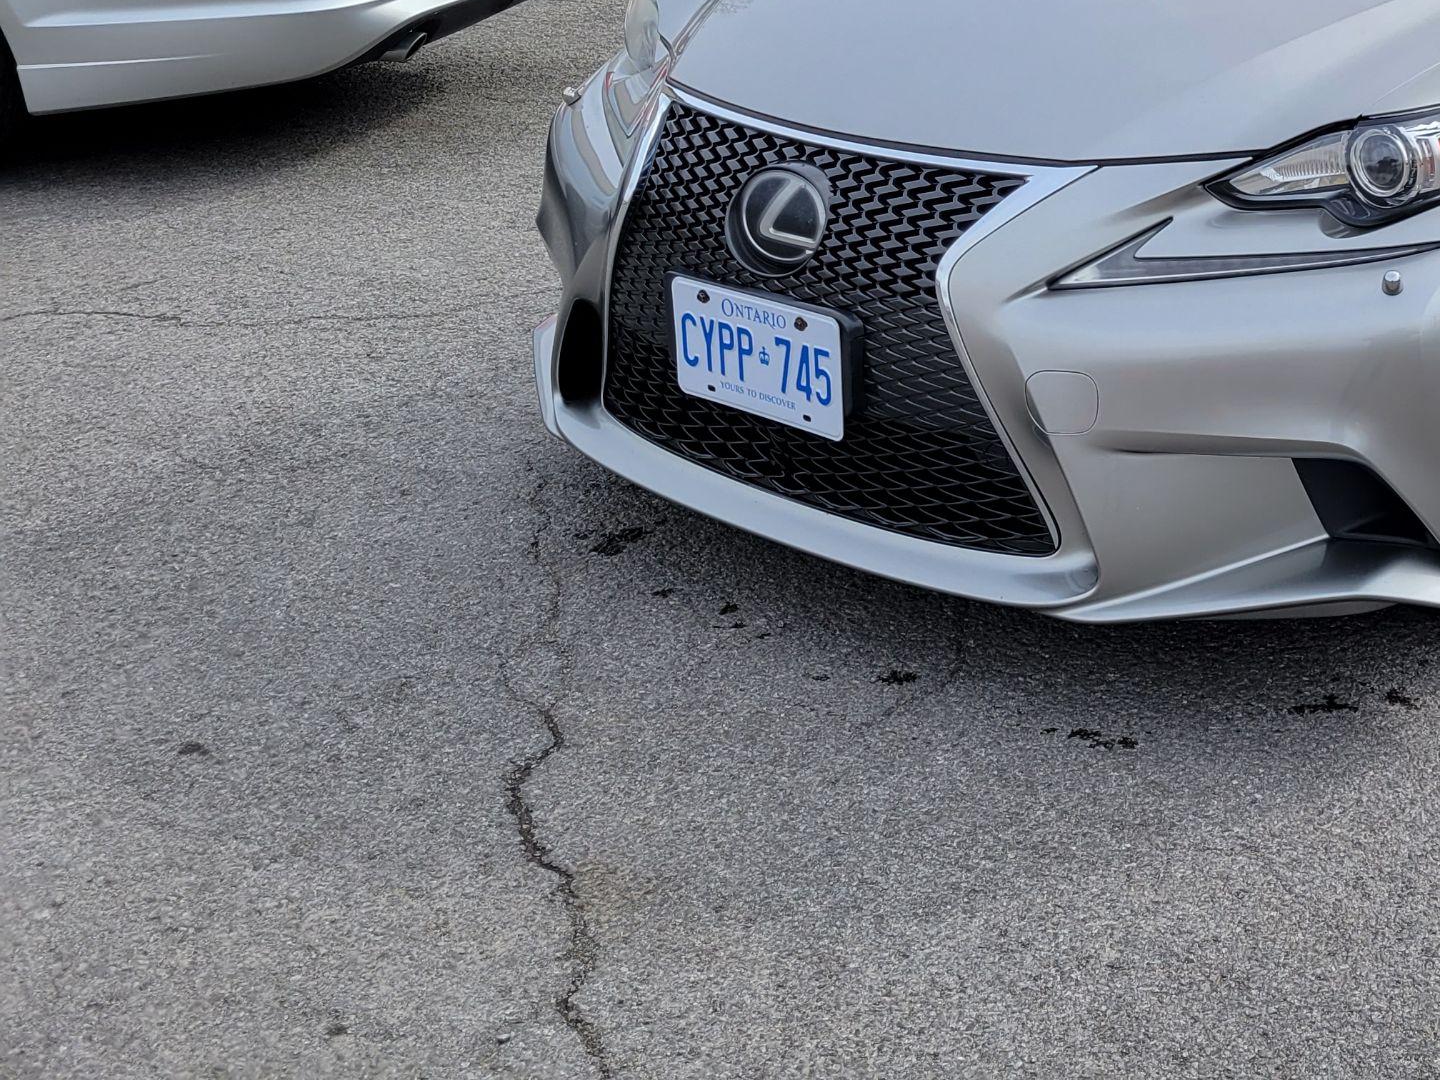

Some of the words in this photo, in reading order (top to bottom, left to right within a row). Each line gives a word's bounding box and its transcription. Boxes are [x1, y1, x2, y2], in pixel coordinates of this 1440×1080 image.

[721, 298, 787, 331] ONTARIO
[681, 312, 754, 382] CYPP
[774, 336, 832, 406] 745
[720, 380, 745, 395] YOURS
[747, 389, 757, 398] TO
[759, 393, 796, 410] DISCOVER
